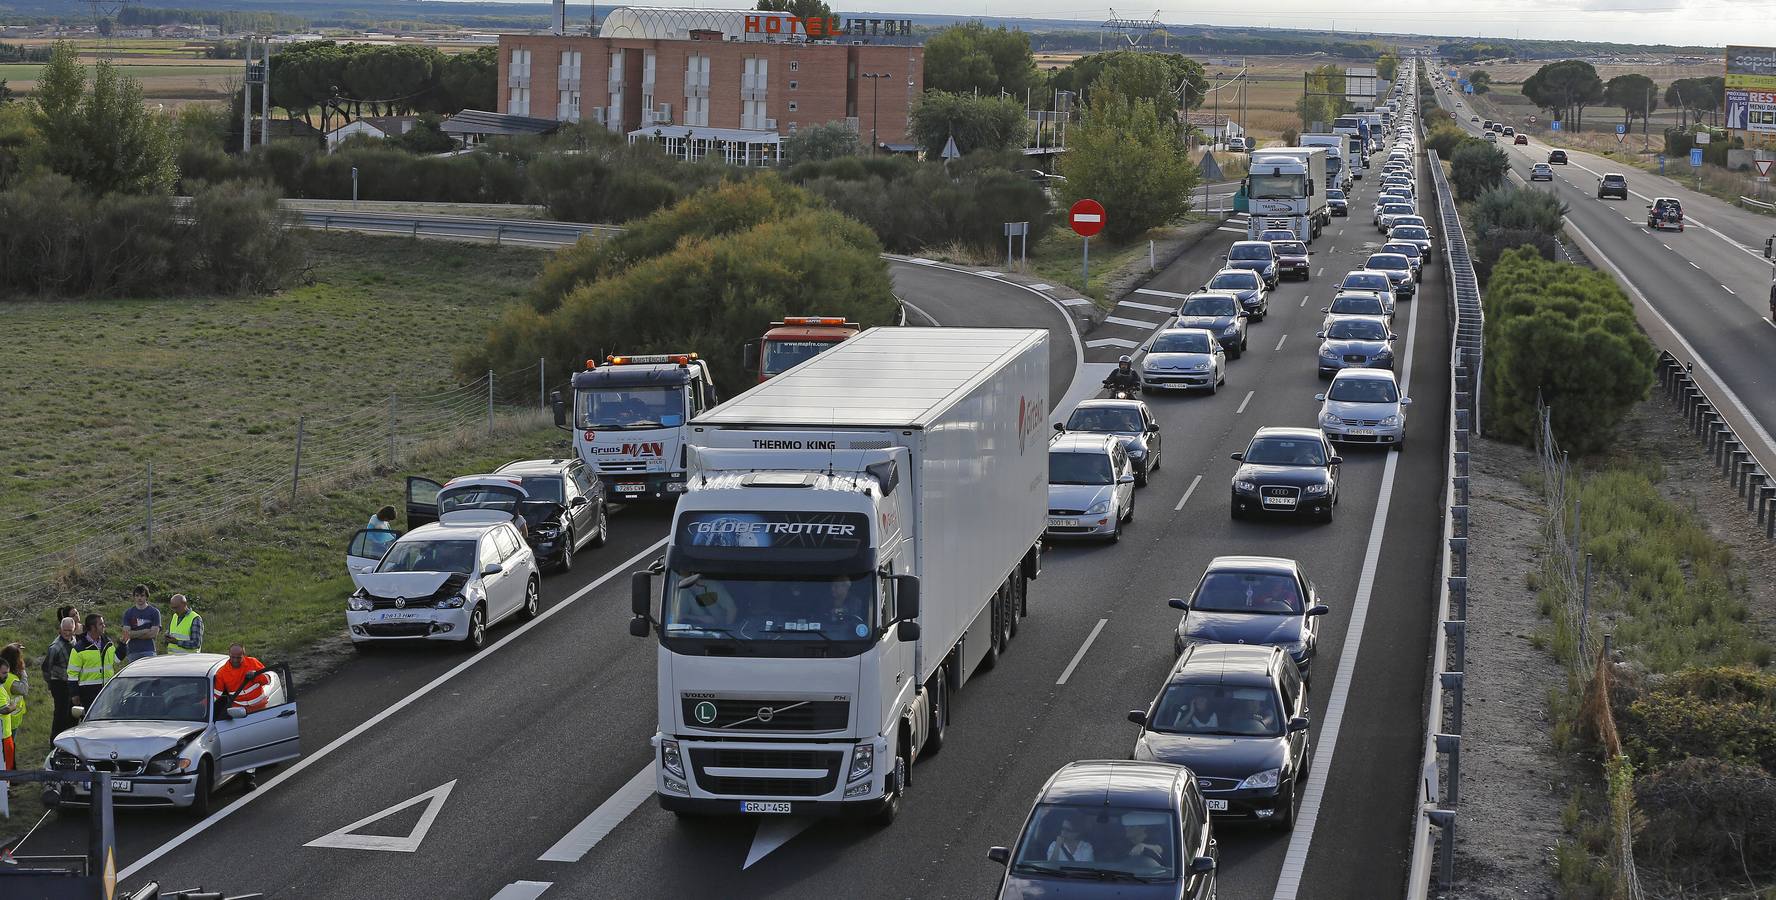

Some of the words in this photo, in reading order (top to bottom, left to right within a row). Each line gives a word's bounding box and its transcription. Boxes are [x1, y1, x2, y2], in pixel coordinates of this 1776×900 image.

[745, 15, 844, 36] HOTEL
[621, 442, 664, 457] MAN
[752, 439, 802, 450] THERMO
[807, 440, 836, 450] KING
[696, 522, 855, 535] GLOBETROTTER
[1208, 800, 1227, 810] CRJ
